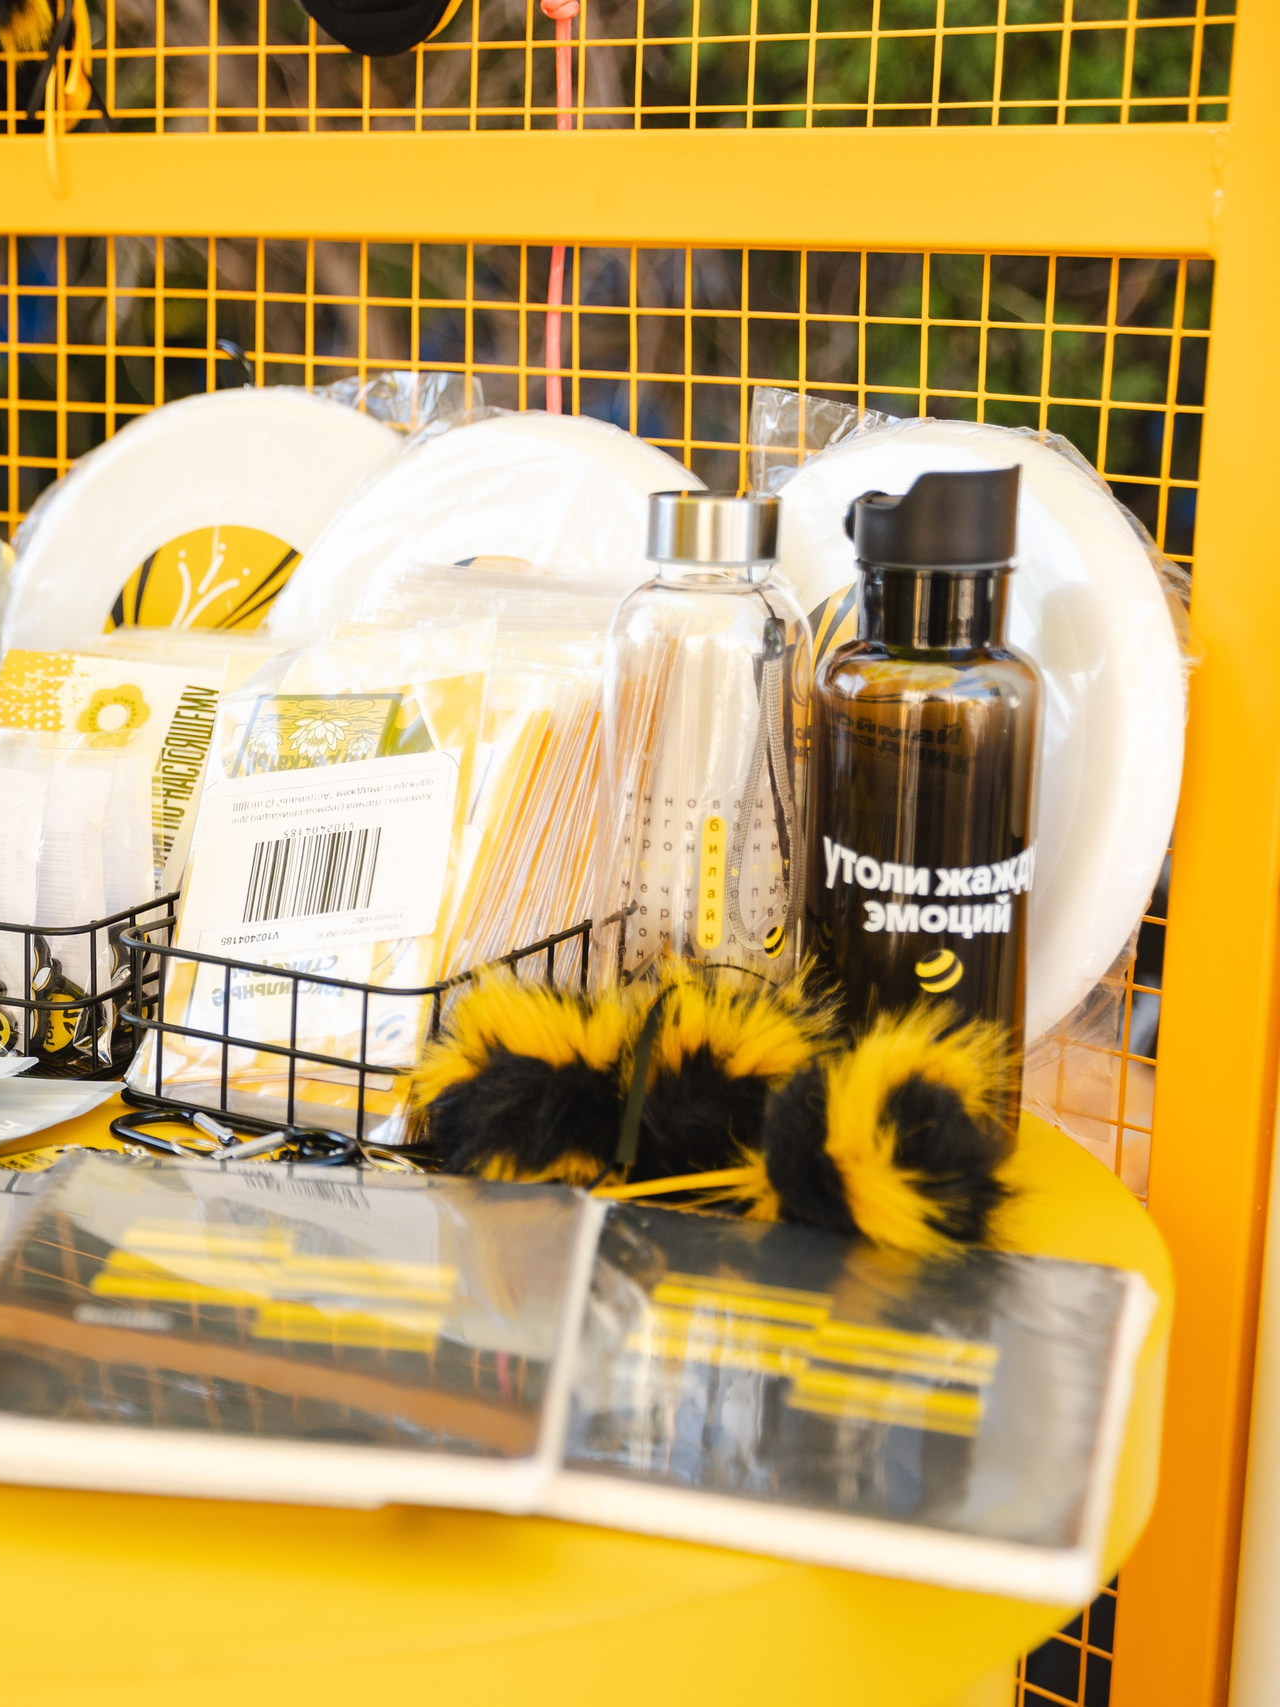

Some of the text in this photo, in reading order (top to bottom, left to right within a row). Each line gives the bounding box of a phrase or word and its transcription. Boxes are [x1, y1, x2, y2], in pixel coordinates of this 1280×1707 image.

[336, 785, 384, 799] имиджем
[283, 821, 355, 839] V102404185
[823, 836, 930, 896] утоли
[863, 893, 1012, 939] эмоций
[221, 931, 279, 946] V102404185
